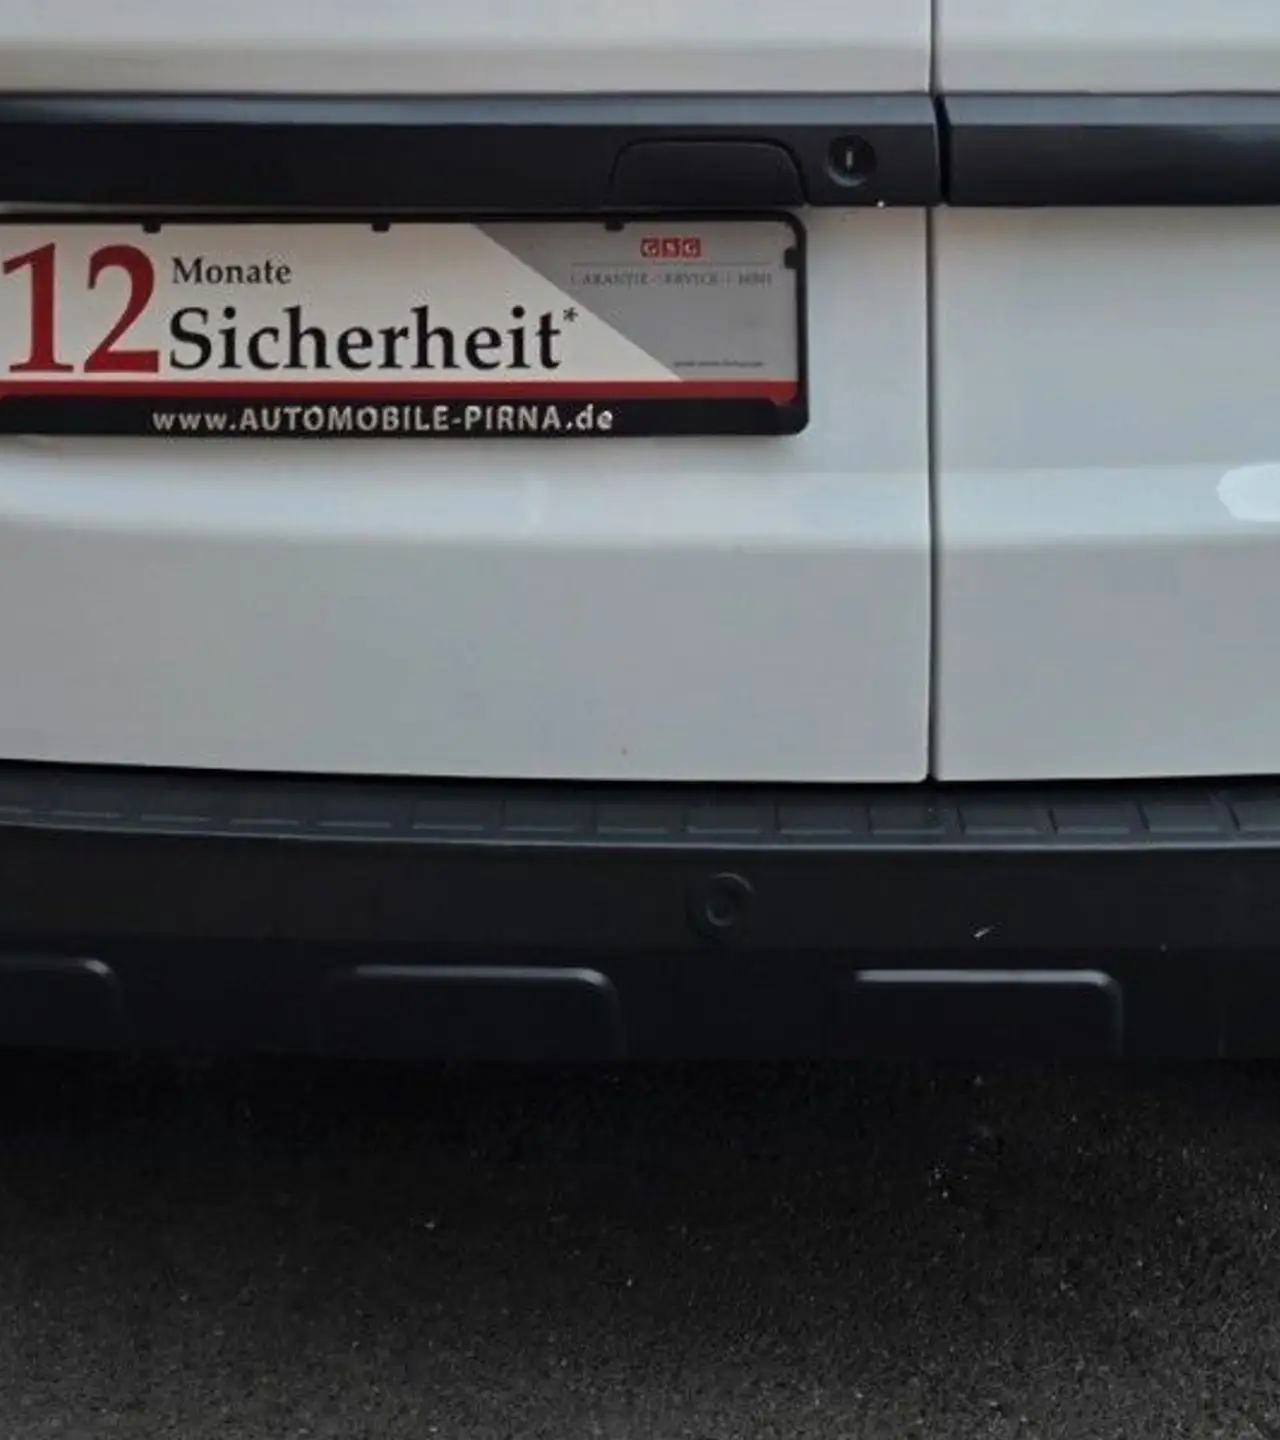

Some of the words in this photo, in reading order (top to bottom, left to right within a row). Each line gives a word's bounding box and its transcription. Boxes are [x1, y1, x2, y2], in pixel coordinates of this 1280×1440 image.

[170, 256, 292, 287] Monate
[2, 242, 161, 374] 12
[151, 405, 613, 433] www.AUTOMOBILE-PIRNA.de
